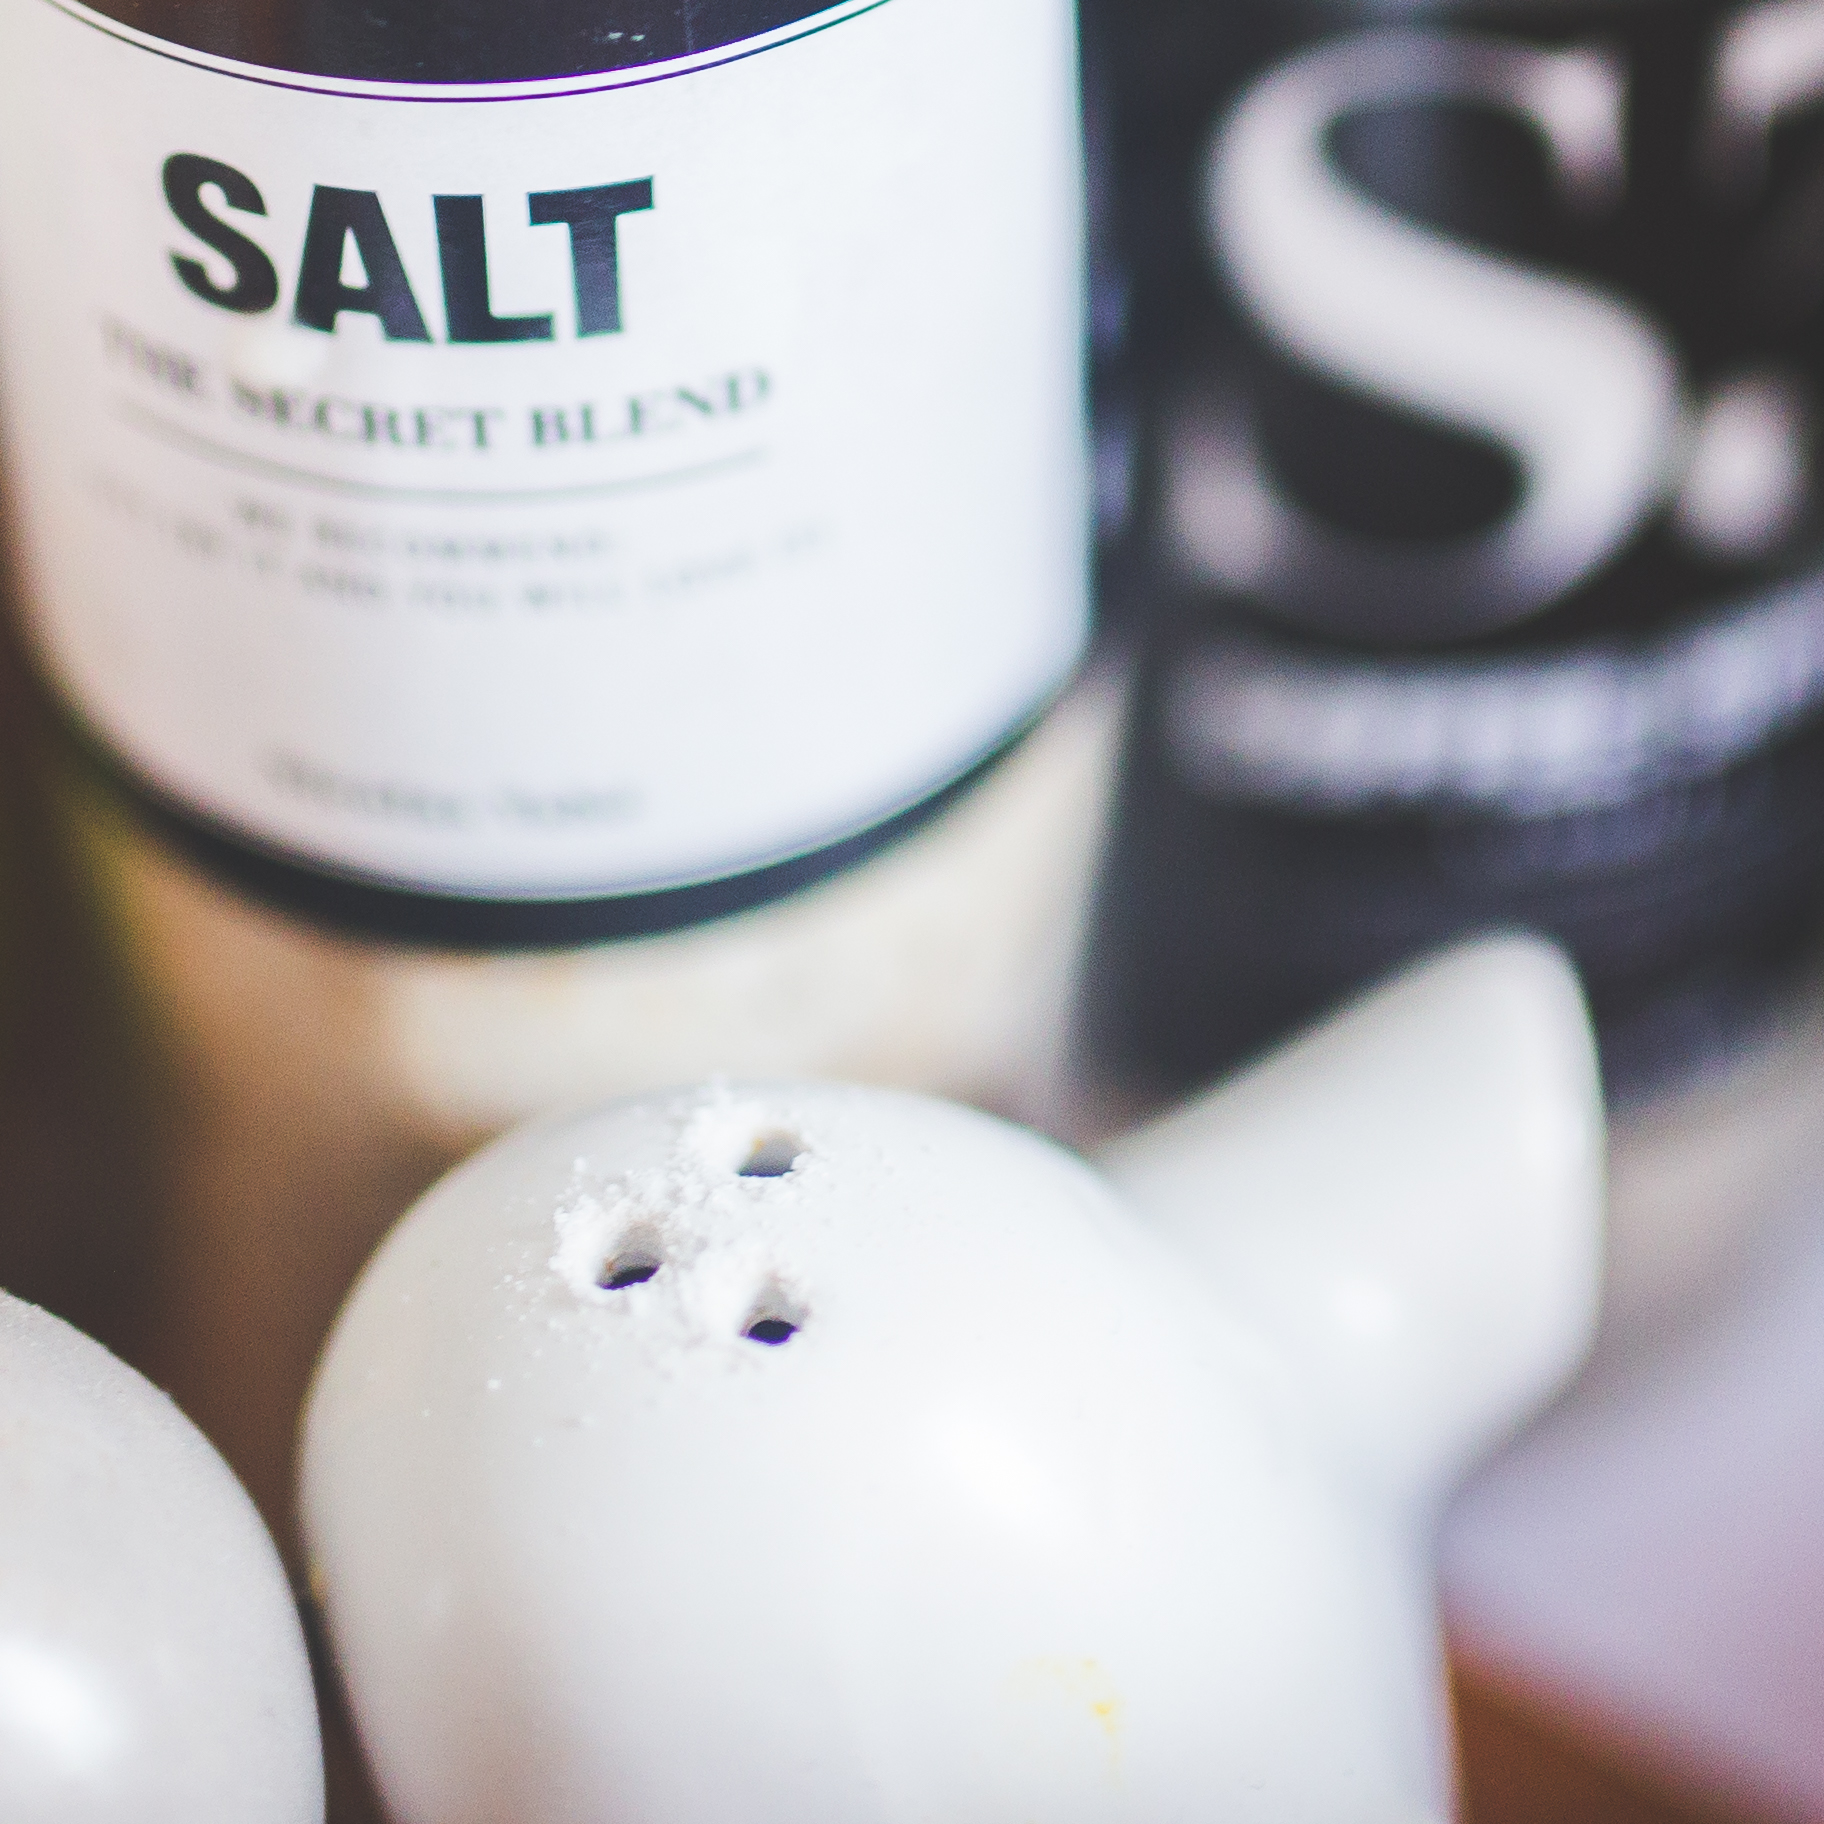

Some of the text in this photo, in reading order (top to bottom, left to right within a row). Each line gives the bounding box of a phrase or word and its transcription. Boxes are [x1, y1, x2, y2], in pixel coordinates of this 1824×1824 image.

[159, 151, 655, 344] SALT
[230, 374, 506, 452] SECRET
[529, 366, 772, 450] BLEND
